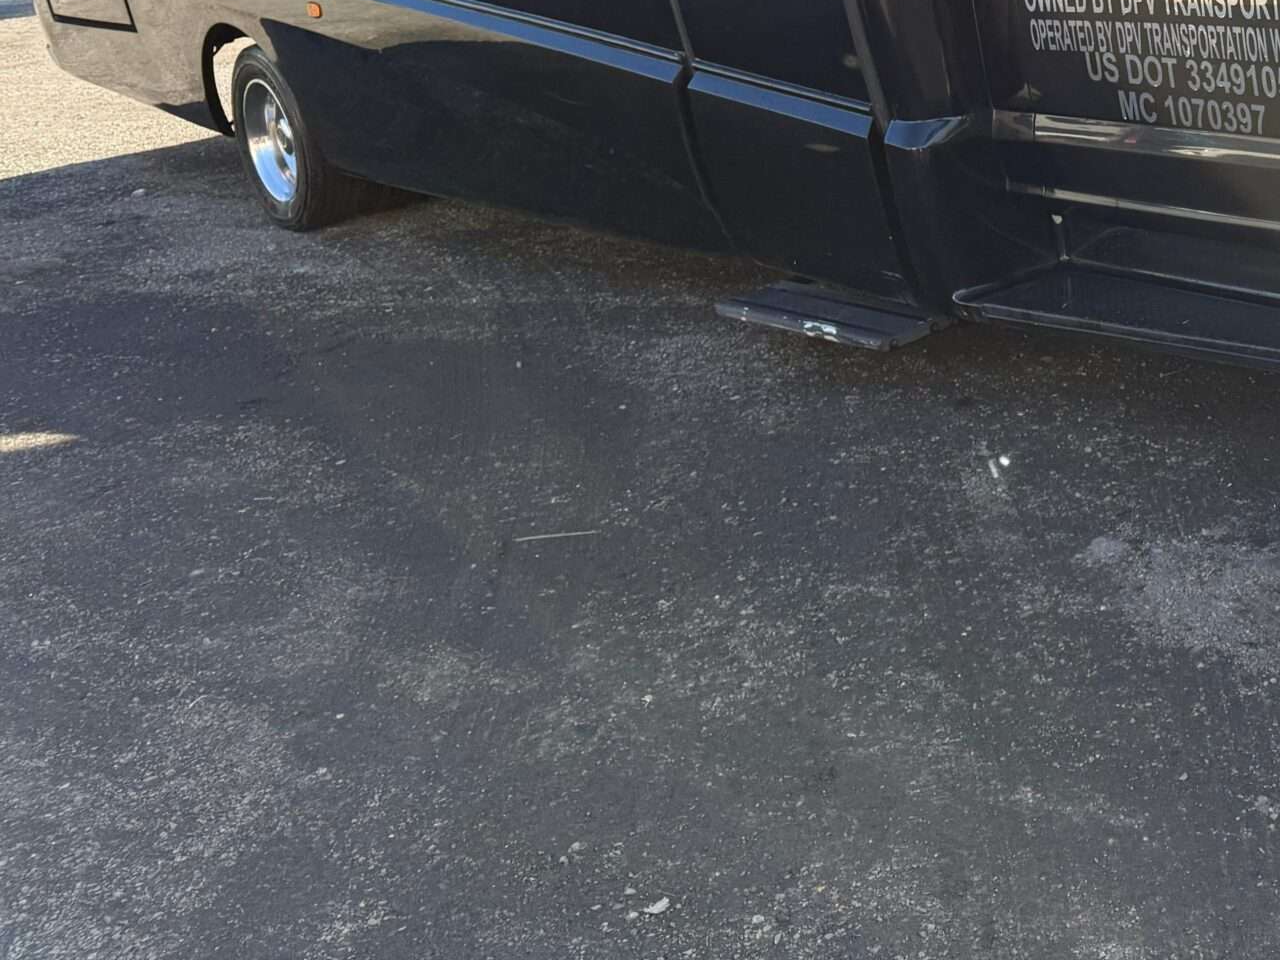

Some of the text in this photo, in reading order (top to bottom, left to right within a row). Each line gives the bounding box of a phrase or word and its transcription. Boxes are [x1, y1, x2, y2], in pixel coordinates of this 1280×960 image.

[1030, 18, 1095, 52] OPERATED
[1096, 20, 1114, 53] BY
[1115, 21, 1142, 54] DPV
[1144, 22, 1269, 62] TRANSPORTATION
[1085, 51, 1119, 83] US
[1125, 54, 1177, 88] DOT
[1118, 89, 1265, 135] MC 1070397
